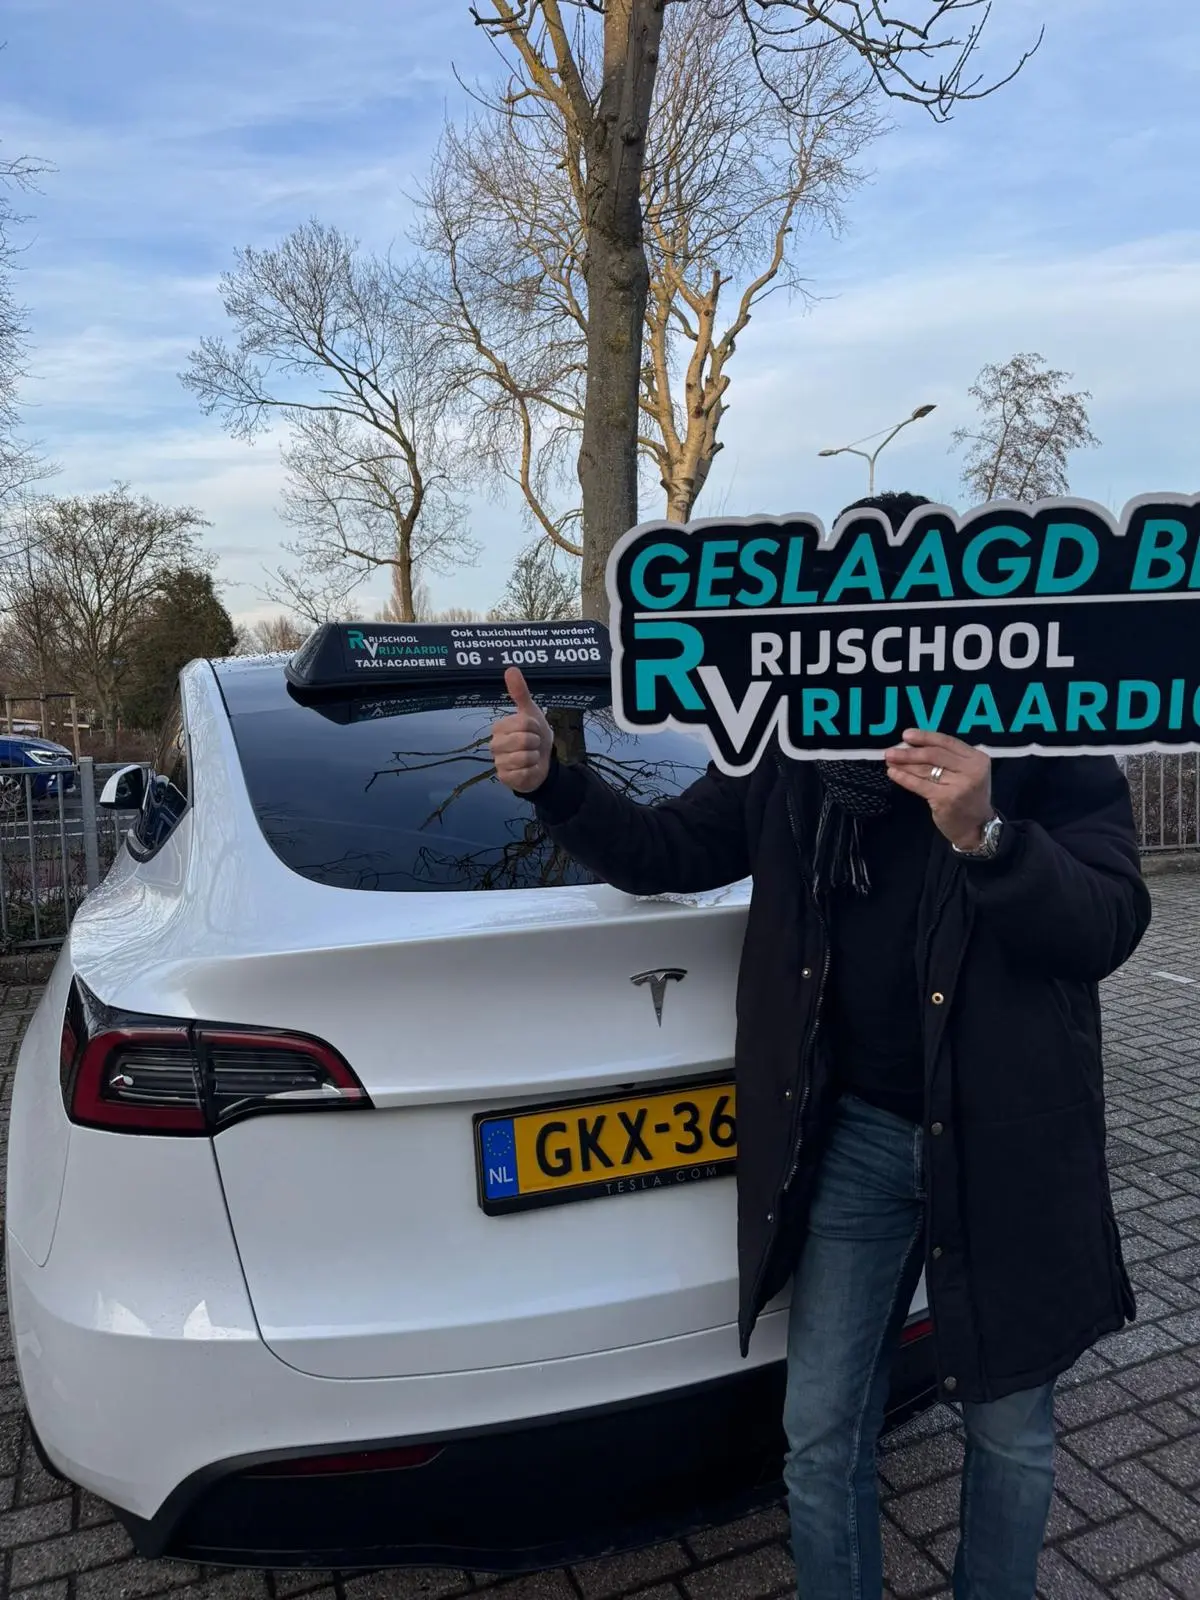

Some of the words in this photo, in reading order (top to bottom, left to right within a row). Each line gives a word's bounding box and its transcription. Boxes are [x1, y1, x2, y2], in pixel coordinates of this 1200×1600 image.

[629, 522, 1100, 610] GESLAAGD
[451, 629, 473, 637] Ook
[476, 628, 548, 637] taxichauffeur
[551, 627, 595, 636] worden?
[379, 646, 448, 655] RIJVAARDIG
[453, 637, 599, 648] RIJSCHOOLRIJVAARDIG.NL
[751, 621, 1075, 676] RIJSCHOOL
[355, 658, 447, 668] TAXI-ACADEMIE
[456, 651, 482, 665] 06
[500, 650, 549, 664] 1005
[554, 648, 601, 662] 4008
[802, 678, 1200, 737] RIJVAARDI
[489, 1167, 513, 1185] NL
[606, 1166, 718, 1195] TESLA.COM
